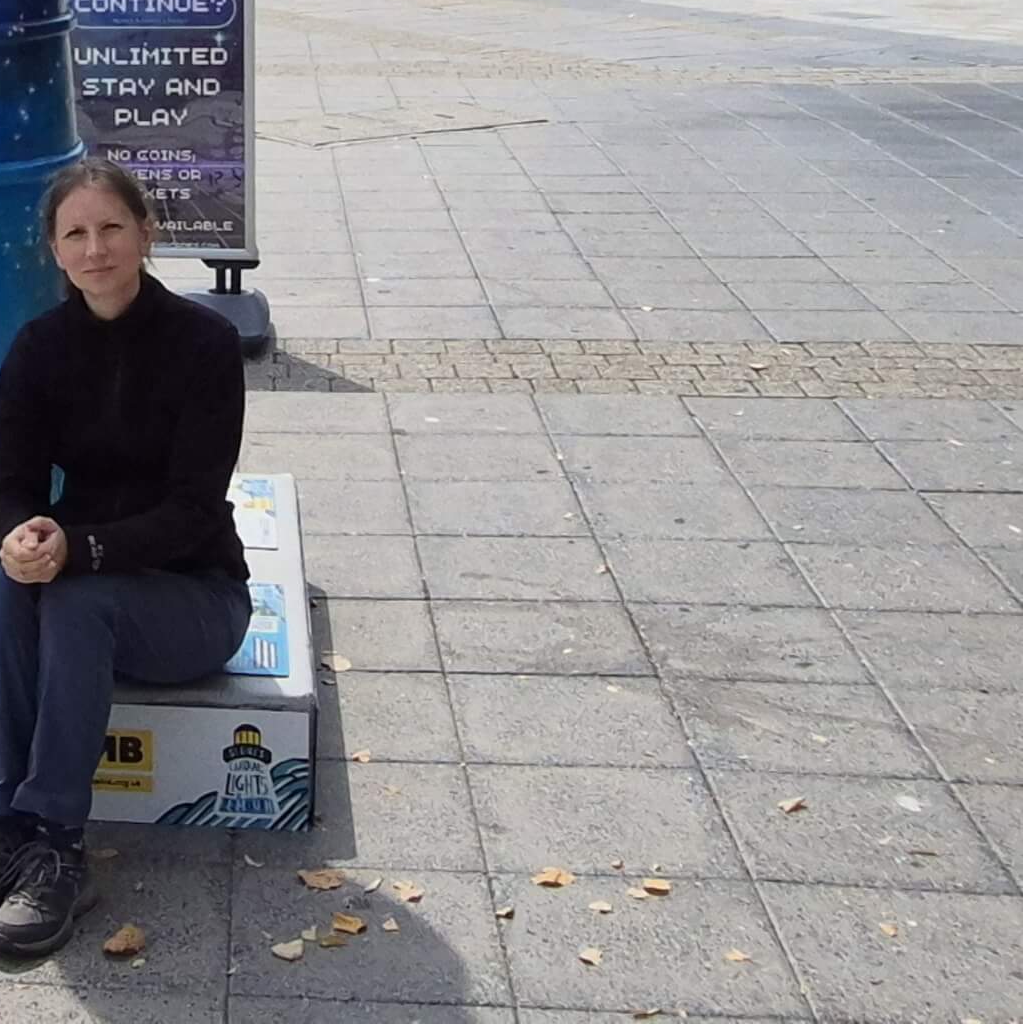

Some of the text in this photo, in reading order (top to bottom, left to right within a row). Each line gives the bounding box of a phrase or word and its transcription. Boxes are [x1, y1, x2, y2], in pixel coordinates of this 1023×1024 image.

[74, 47, 228, 65] UNLIMITED
[82, 78, 221, 96] STAY AND
[114, 108, 188, 126] PLAY
[107, 149, 196, 163] NO COINS,
[178, 169, 201, 180] OR
[144, 188, 191, 200] KETS
[154, 220, 233, 232] VAILABLE
[224, 772, 269, 795] LIGHTS
